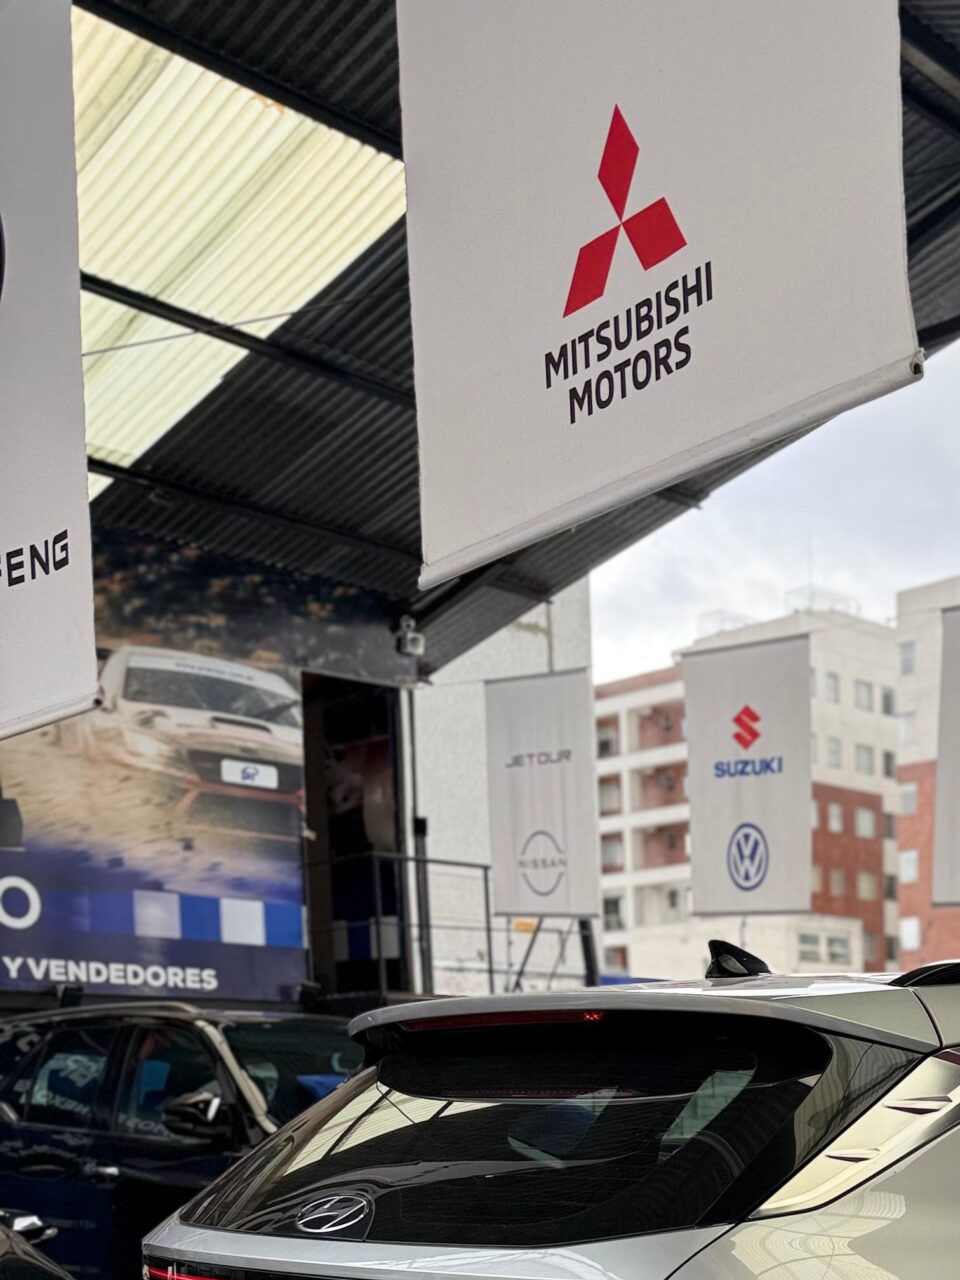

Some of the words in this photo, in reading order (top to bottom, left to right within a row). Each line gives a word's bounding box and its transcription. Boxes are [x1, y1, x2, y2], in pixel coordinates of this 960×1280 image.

[545, 261, 713, 389] MITSUBISHI
[569, 325, 692, 424] MOTORS
[0, 529, 69, 587] ENG
[505, 749, 571, 768] JETOUR
[714, 757, 783, 778] SUZUKI
[518, 858, 567, 870] NISSAN
[2, 956, 23, 979] Y
[27, 957, 218, 990] VENDEDORES
